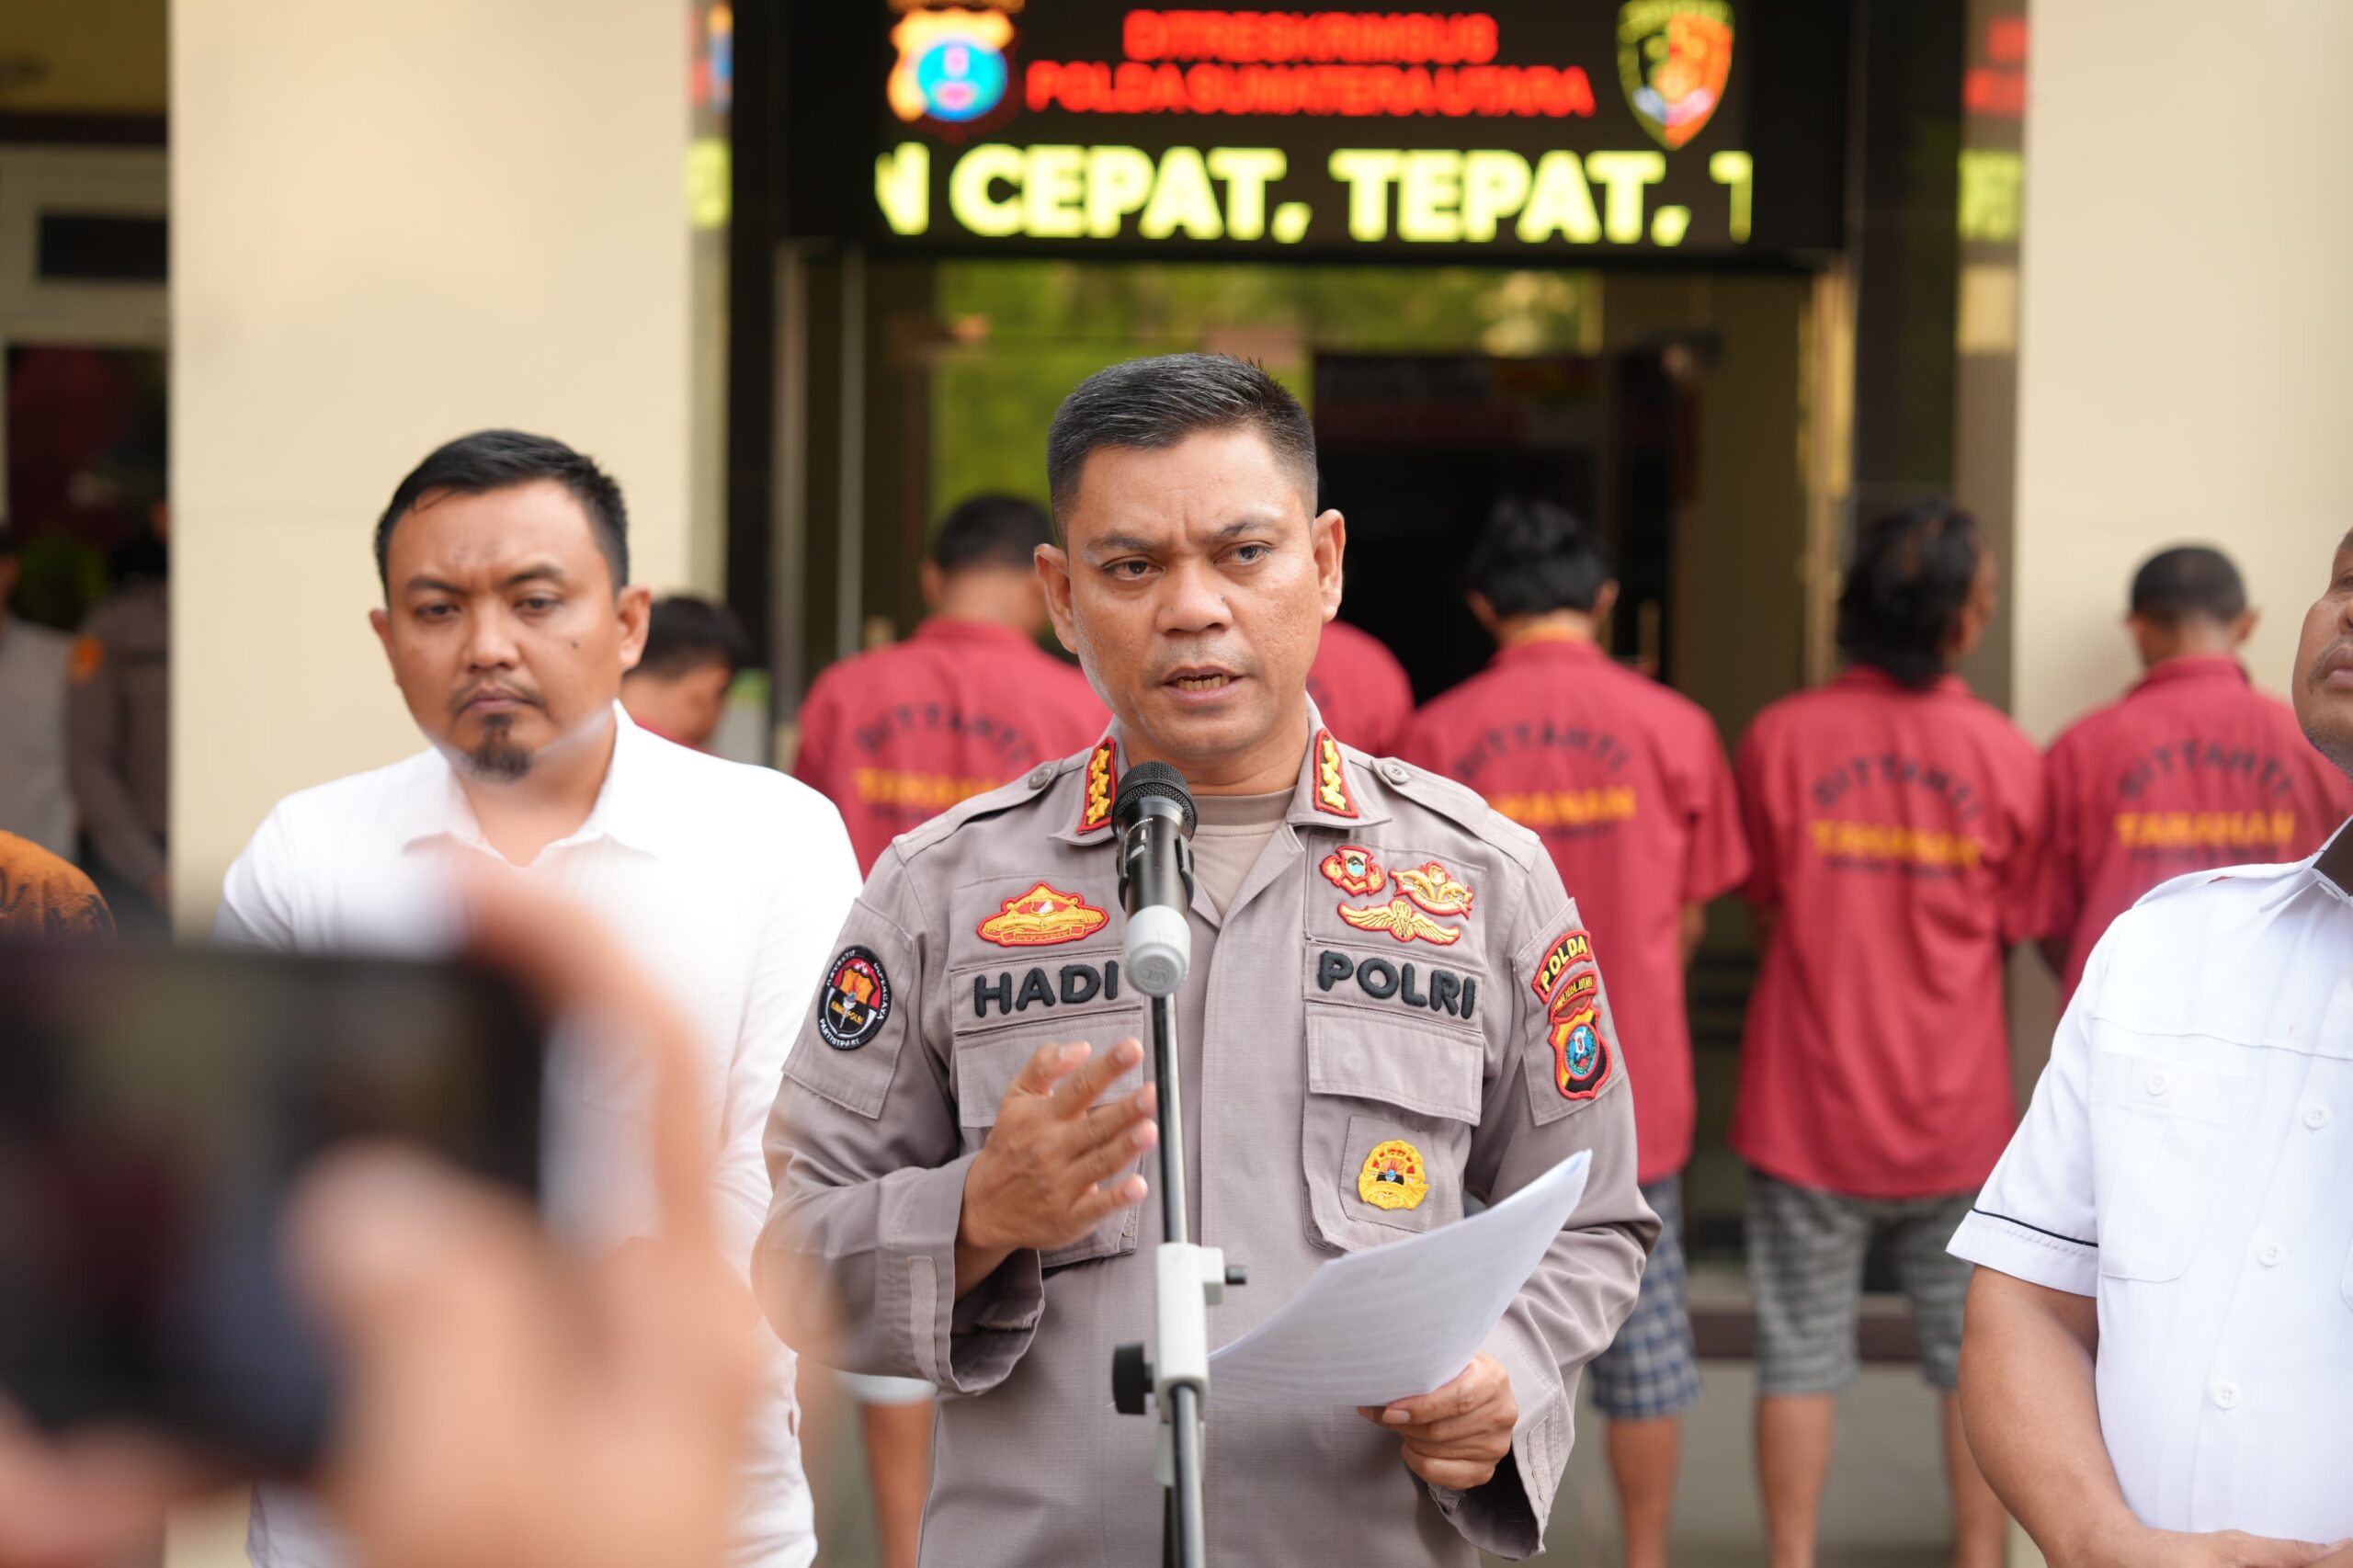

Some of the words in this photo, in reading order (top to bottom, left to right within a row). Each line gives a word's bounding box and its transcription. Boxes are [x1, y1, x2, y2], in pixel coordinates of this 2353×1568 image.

[949, 144, 1313, 244] CEPAT,
[1329, 147, 1691, 246] TEPAT,
[973, 960, 1119, 1017] HADI
[1317, 949, 1475, 1019] POLRI
[1540, 936, 1587, 992] POLDA
